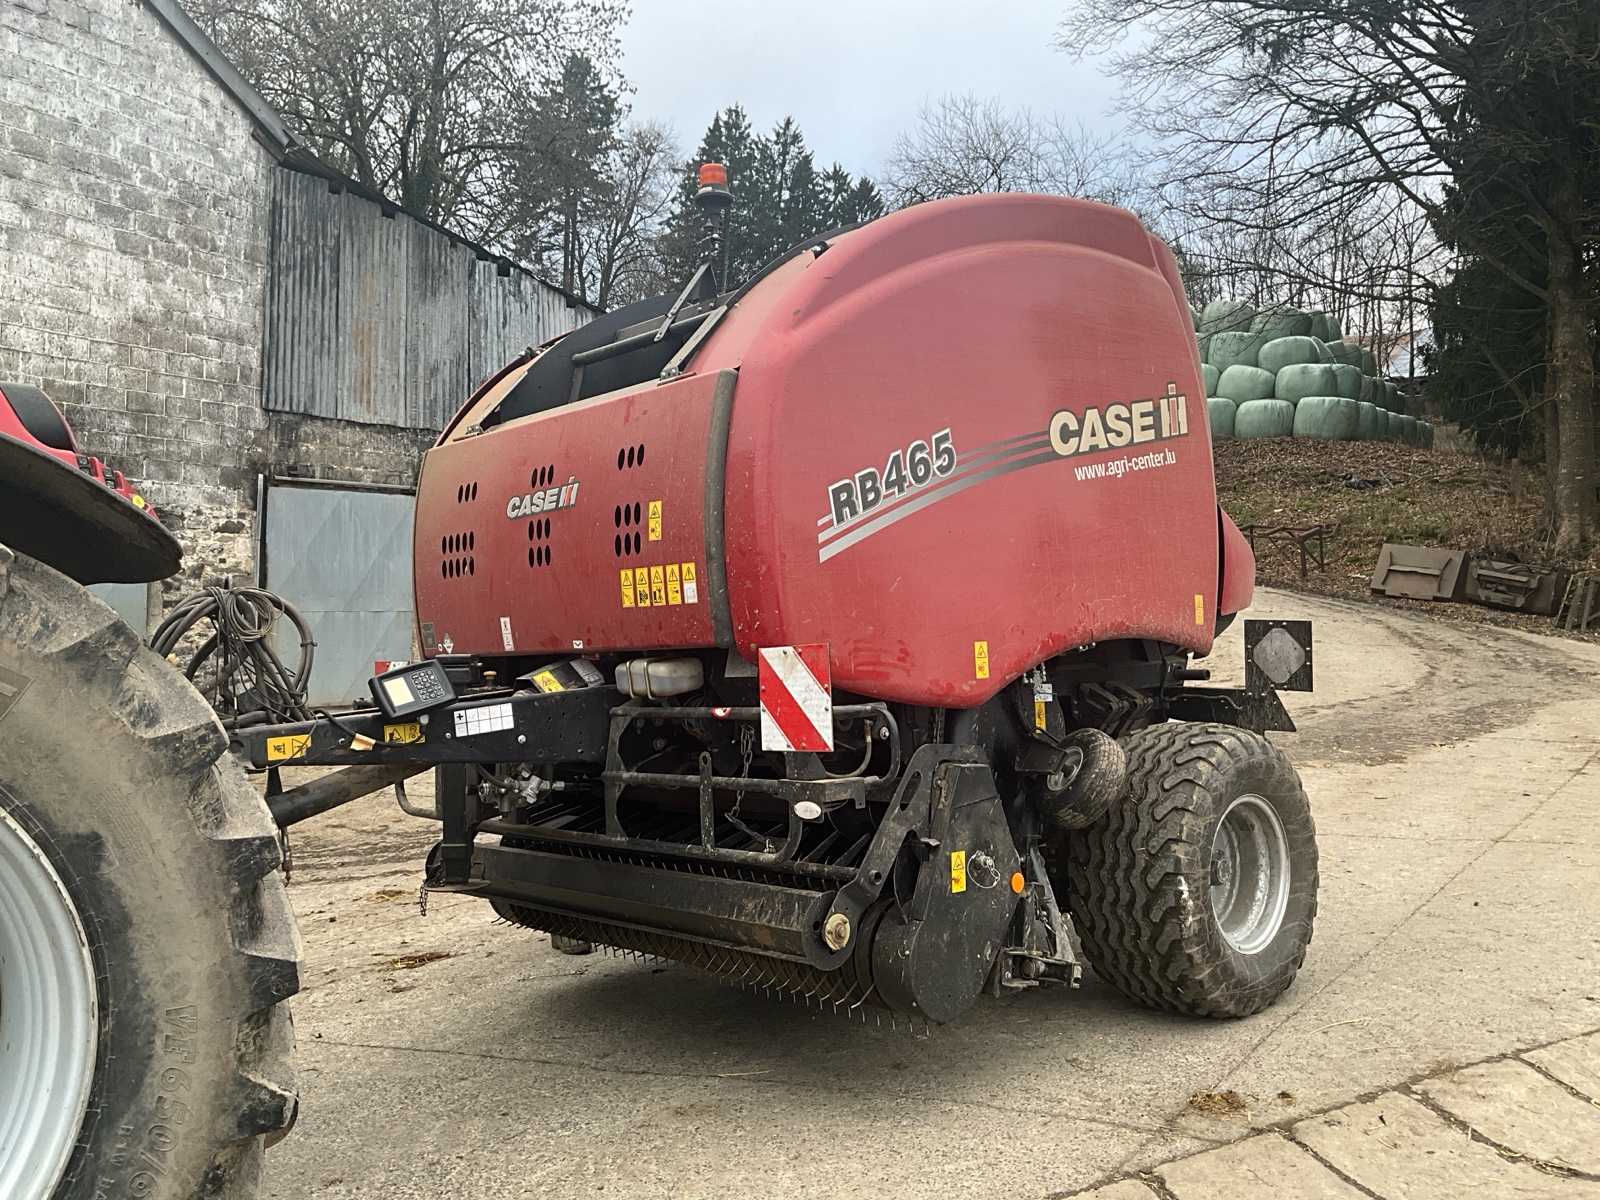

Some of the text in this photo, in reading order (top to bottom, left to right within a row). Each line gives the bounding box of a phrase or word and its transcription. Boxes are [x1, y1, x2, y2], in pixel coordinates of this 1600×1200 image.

[1049, 400, 1156, 456] CASE
[827, 427, 957, 528] RB465
[1074, 448, 1176, 481] www.agri-center.lu
[506, 487, 560, 519] CASE
